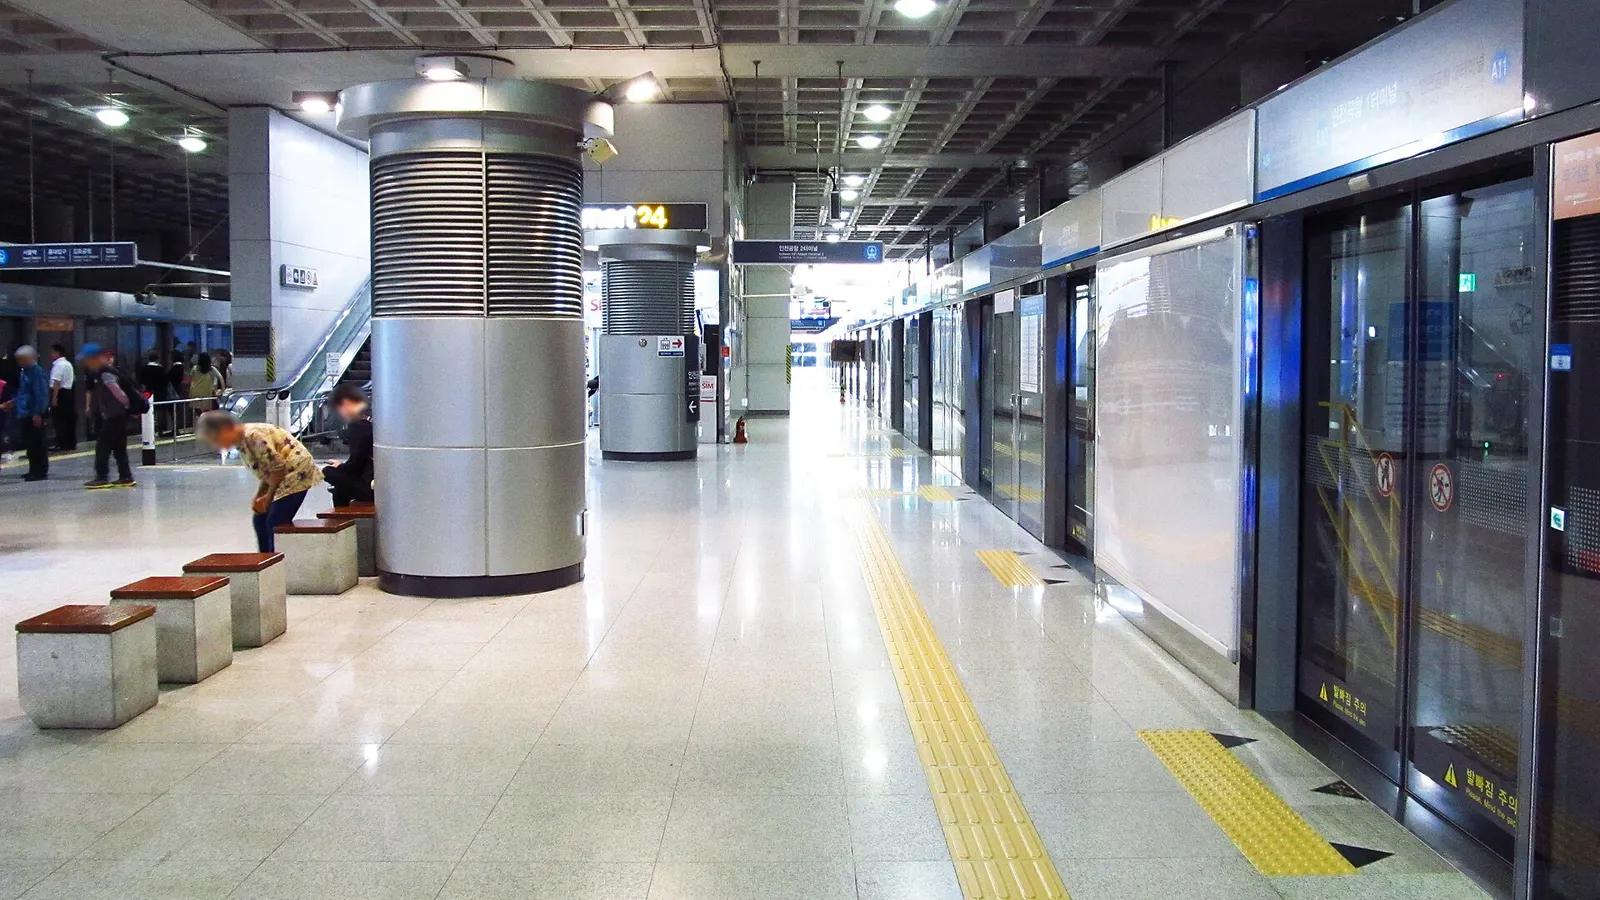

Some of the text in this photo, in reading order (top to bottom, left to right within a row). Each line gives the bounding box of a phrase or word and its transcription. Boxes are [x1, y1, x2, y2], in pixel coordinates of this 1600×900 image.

[1491, 56, 1508, 79] A11
[1366, 80, 1399, 111] 1터미널
[1353, 697, 1366, 716] 주의
[1466, 768, 1518, 815] 발빠짐 주의
